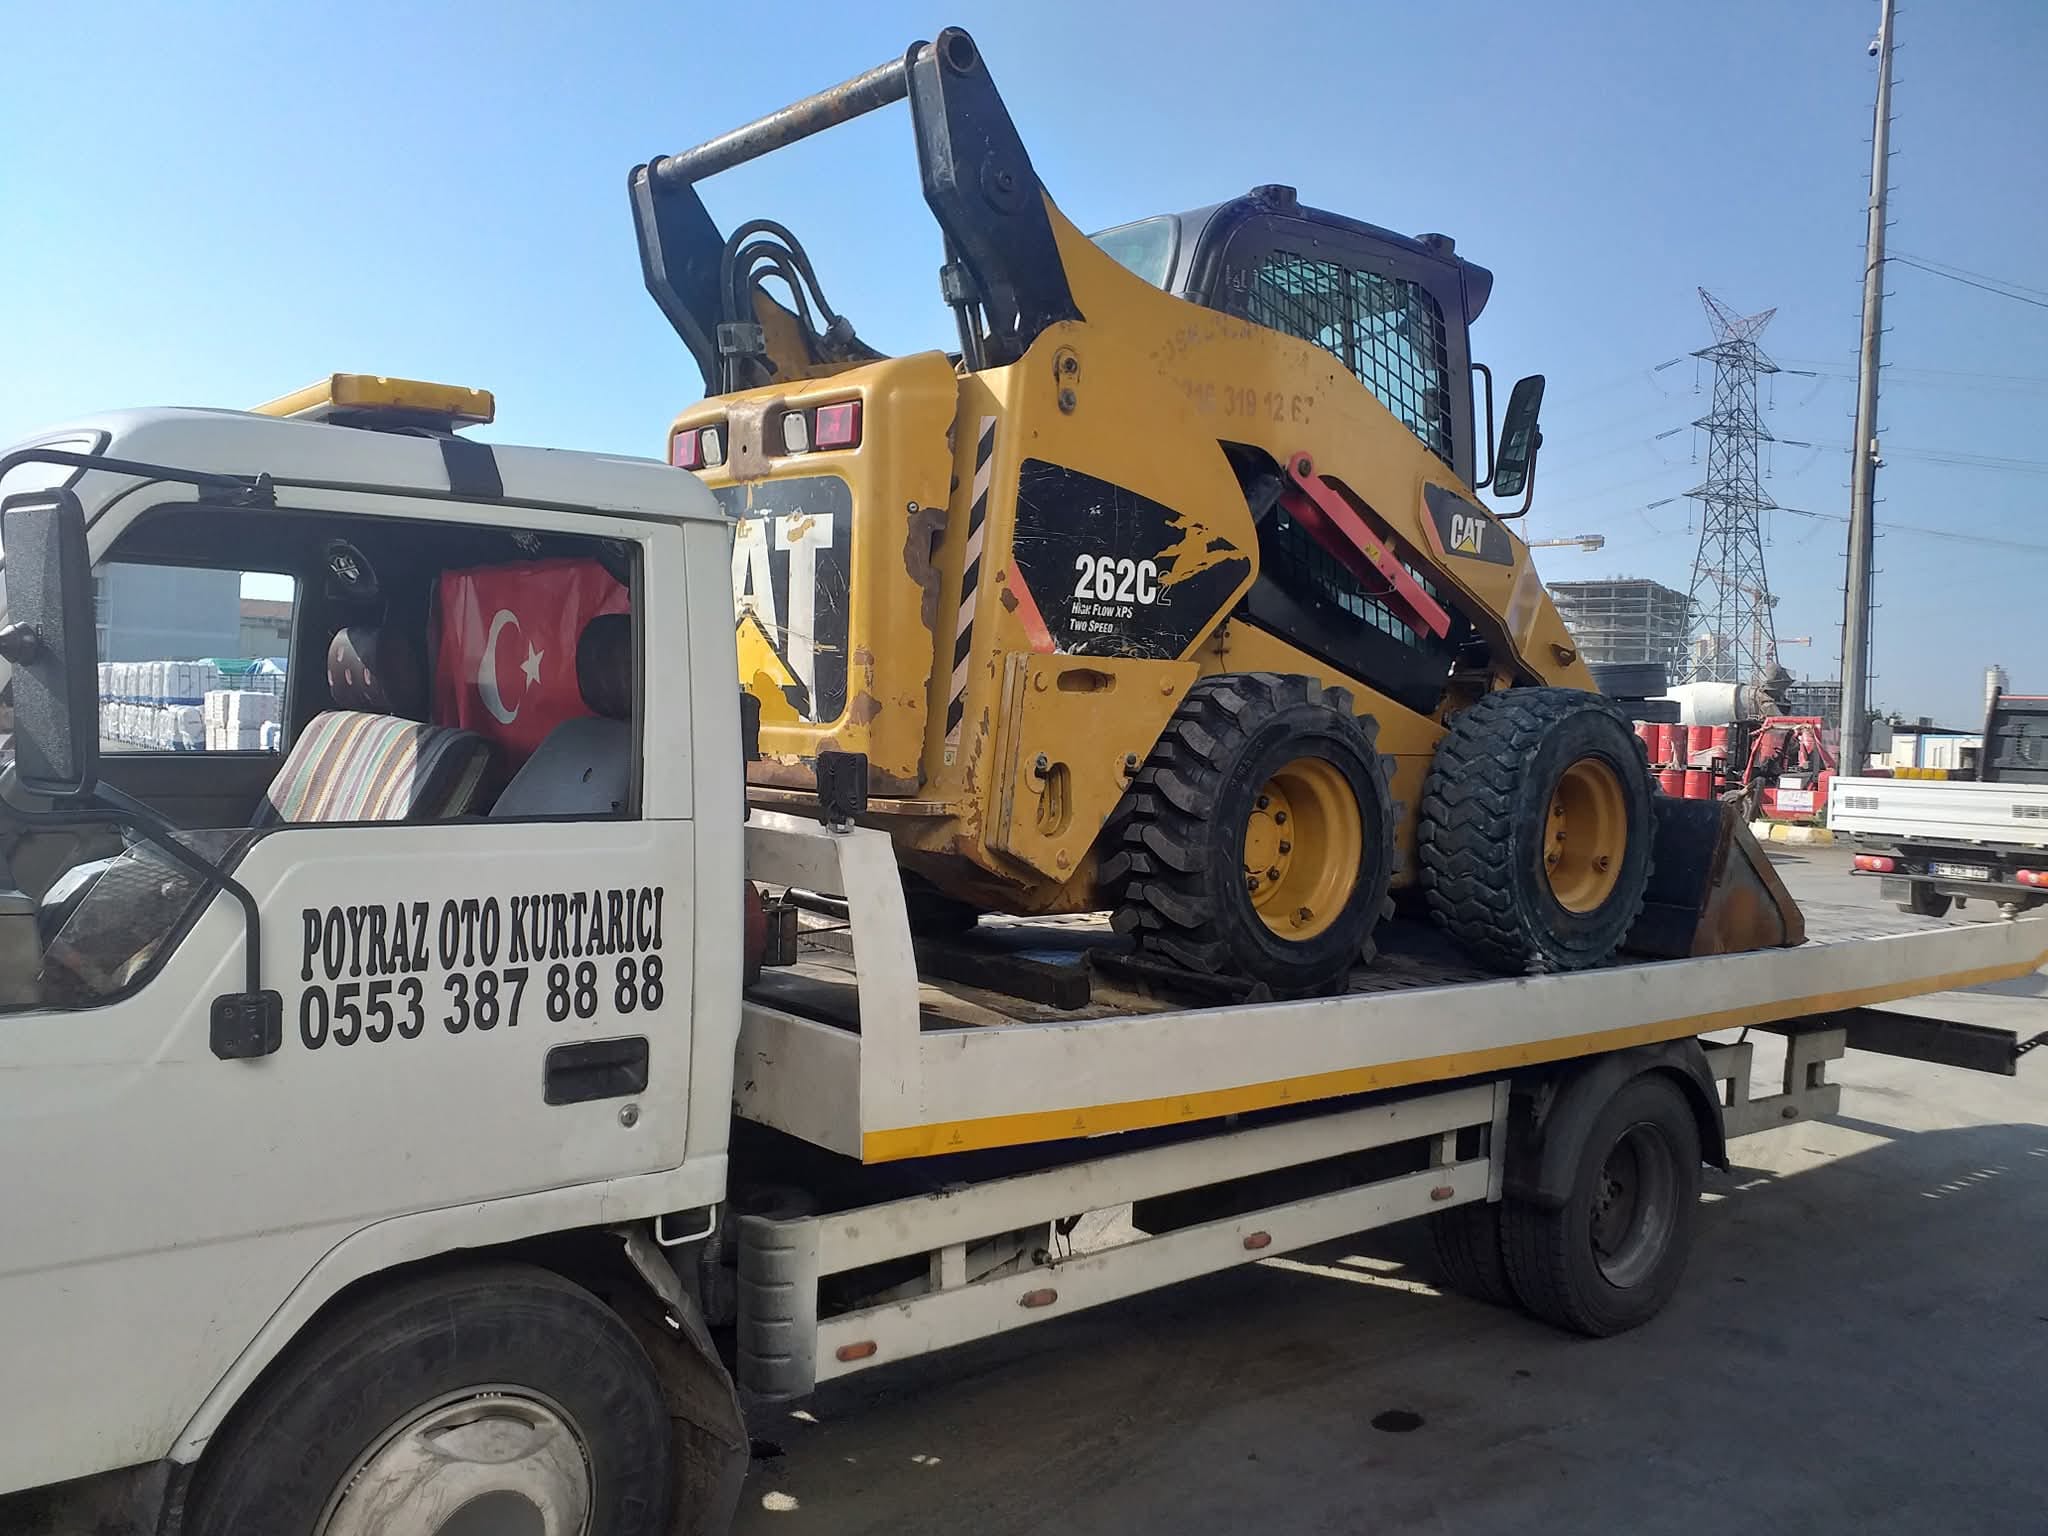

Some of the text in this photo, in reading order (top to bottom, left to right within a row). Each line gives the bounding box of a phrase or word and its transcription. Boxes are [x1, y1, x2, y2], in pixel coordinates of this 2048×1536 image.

[1450, 514, 1486, 554] CAT
[731, 513, 834, 723] AT
[1070, 618, 1114, 633] TWO SPEED
[1092, 604, 1114, 617] FLOW
[1115, 606, 1134, 619] XPS
[301, 887, 664, 981] POYRAZ OTO KURTARICI
[300, 955, 664, 1050] 0553 387 88 88
